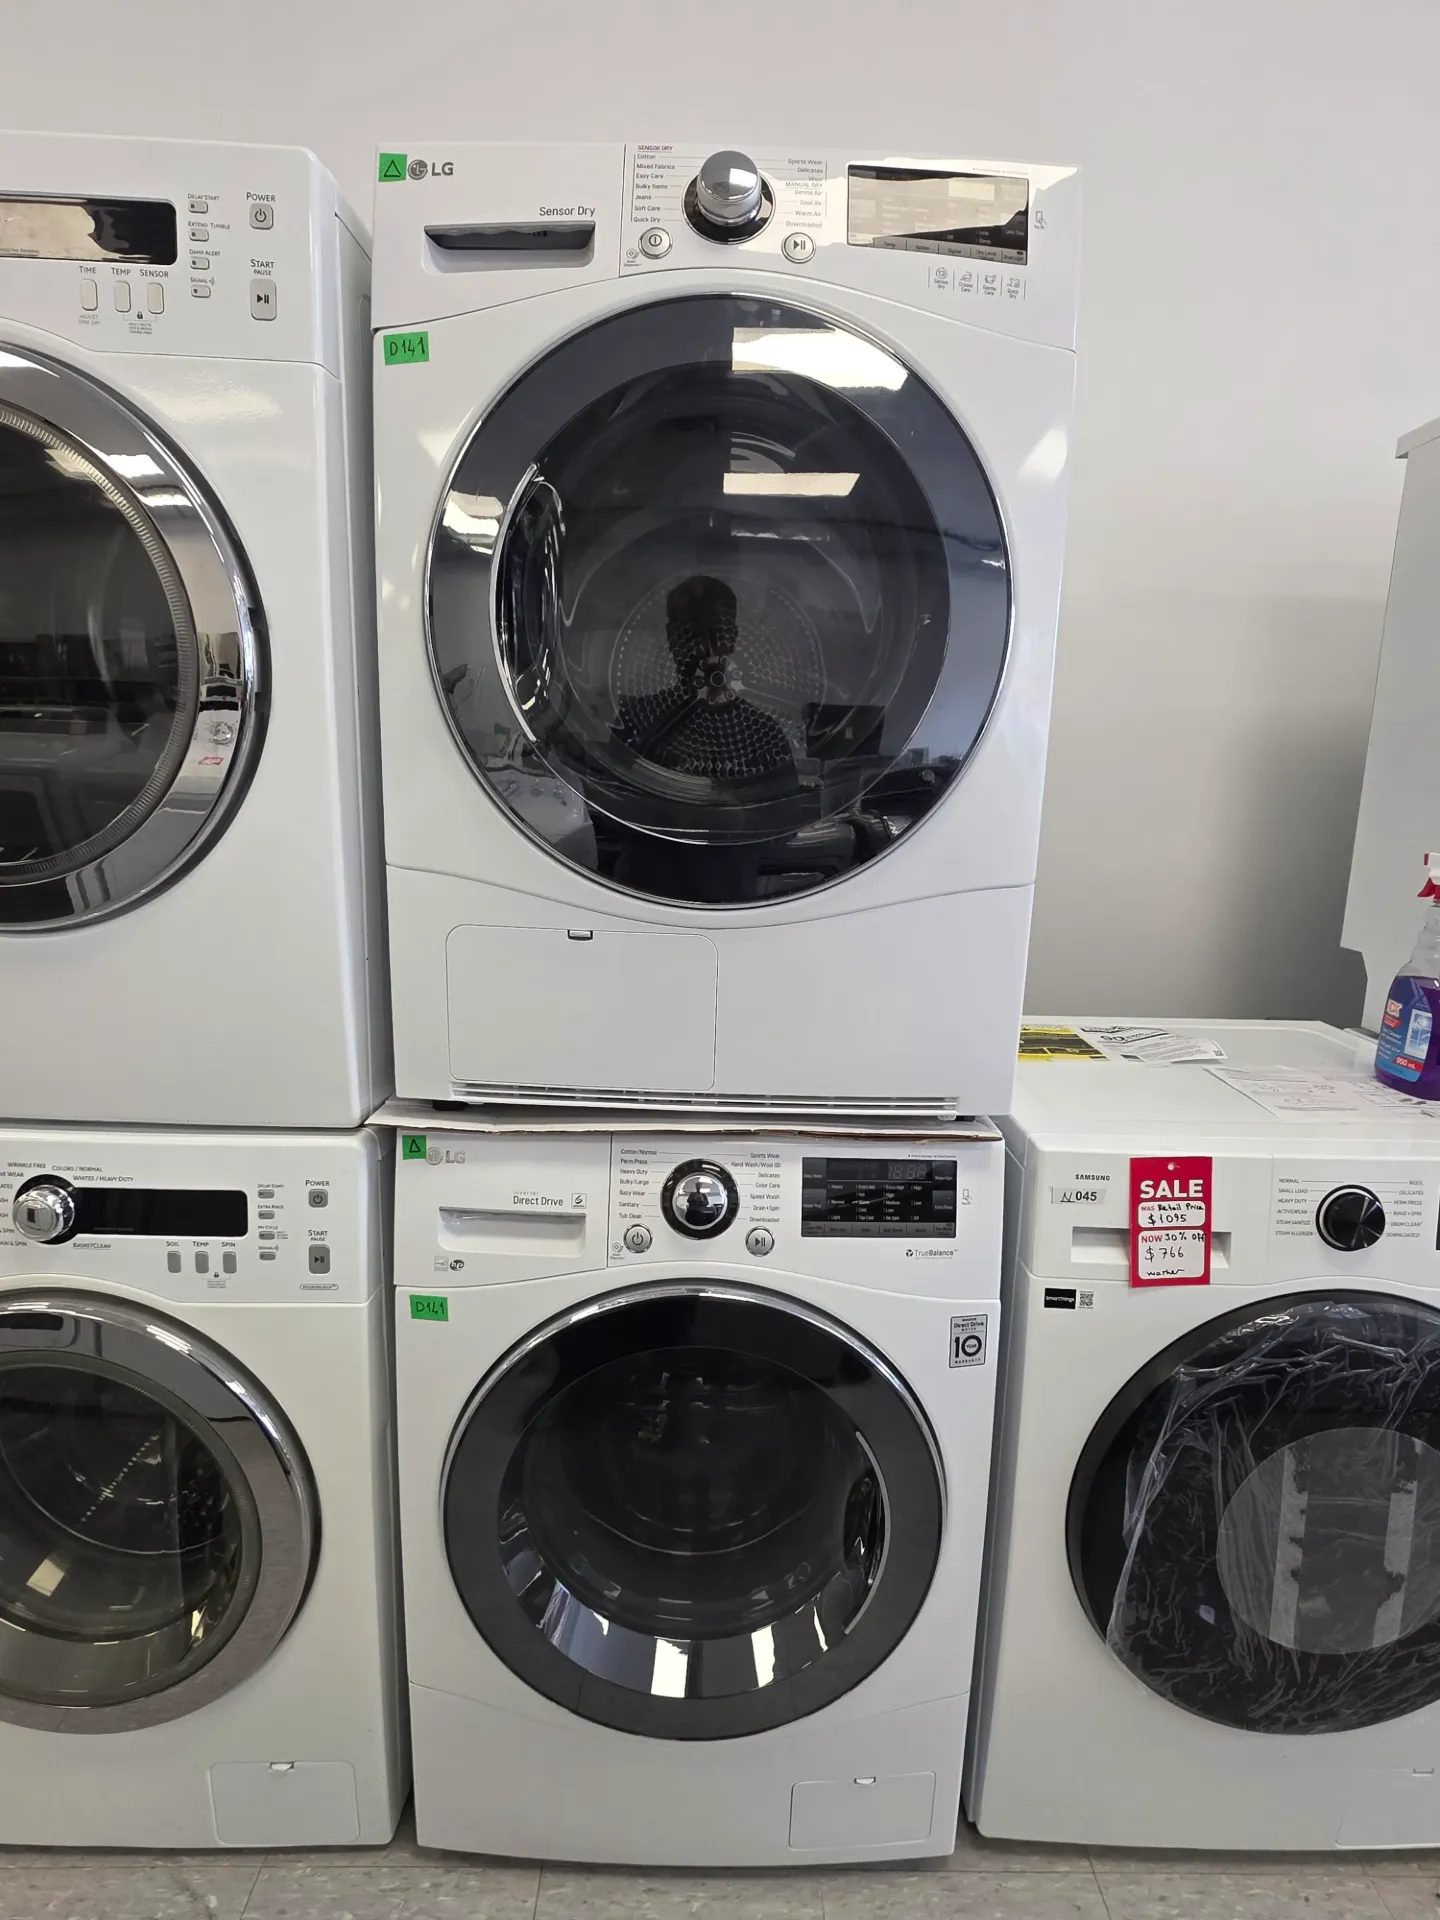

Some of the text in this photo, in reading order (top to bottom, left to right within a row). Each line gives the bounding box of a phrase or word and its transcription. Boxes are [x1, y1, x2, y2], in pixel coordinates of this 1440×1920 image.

[431, 161, 454, 177] LG
[246, 192, 276, 202] POWER
[539, 206, 596, 217] Sensor Dry
[210, 222, 231, 230] TUMBLE
[250, 258, 275, 269] START
[79, 265, 97, 275] TIME
[111, 267, 132, 276] TEMP
[139, 268, 169, 278] SENSOR
[190, 276, 208, 284] SIGNAL
[445, 1150, 466, 1165] LG
[305, 1179, 330, 1187] POWER
[1139, 1179, 1204, 1199] SALE
[512, 1195, 564, 1207] Direct Drive
[618, 1200, 640, 1208] Sanitary
[1157, 1202, 1182, 1212] Retail
[307, 1229, 329, 1237] START
[1141, 1235, 1163, 1244] NOW
[1164, 1231, 1187, 1241] 30%
[954, 1334, 983, 1359] 10
